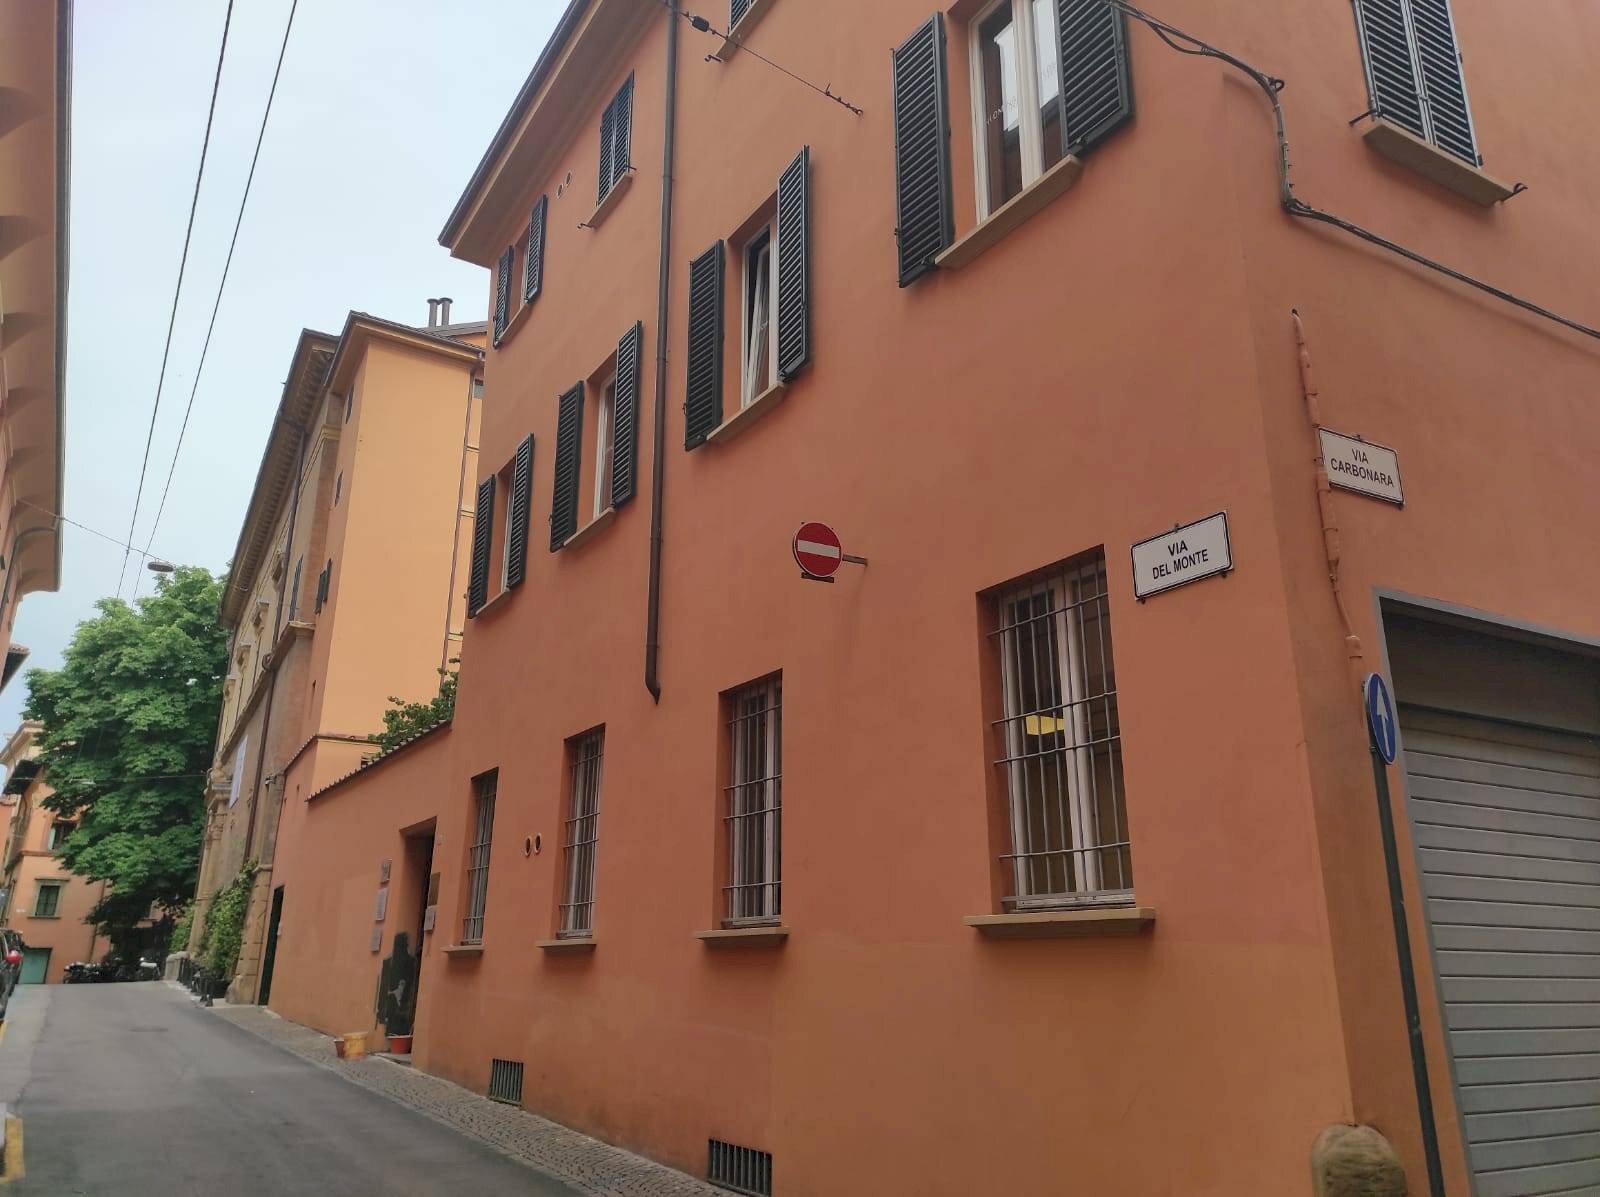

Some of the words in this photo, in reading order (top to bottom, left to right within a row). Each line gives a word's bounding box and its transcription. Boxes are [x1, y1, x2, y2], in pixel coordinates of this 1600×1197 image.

[1351, 448, 1369, 464] VIA
[1331, 457, 1394, 487] CARBONARA
[1167, 540, 1188, 556] VIA
[1152, 563, 1172, 580] DEL
[1173, 549, 1209, 572] MONTE
